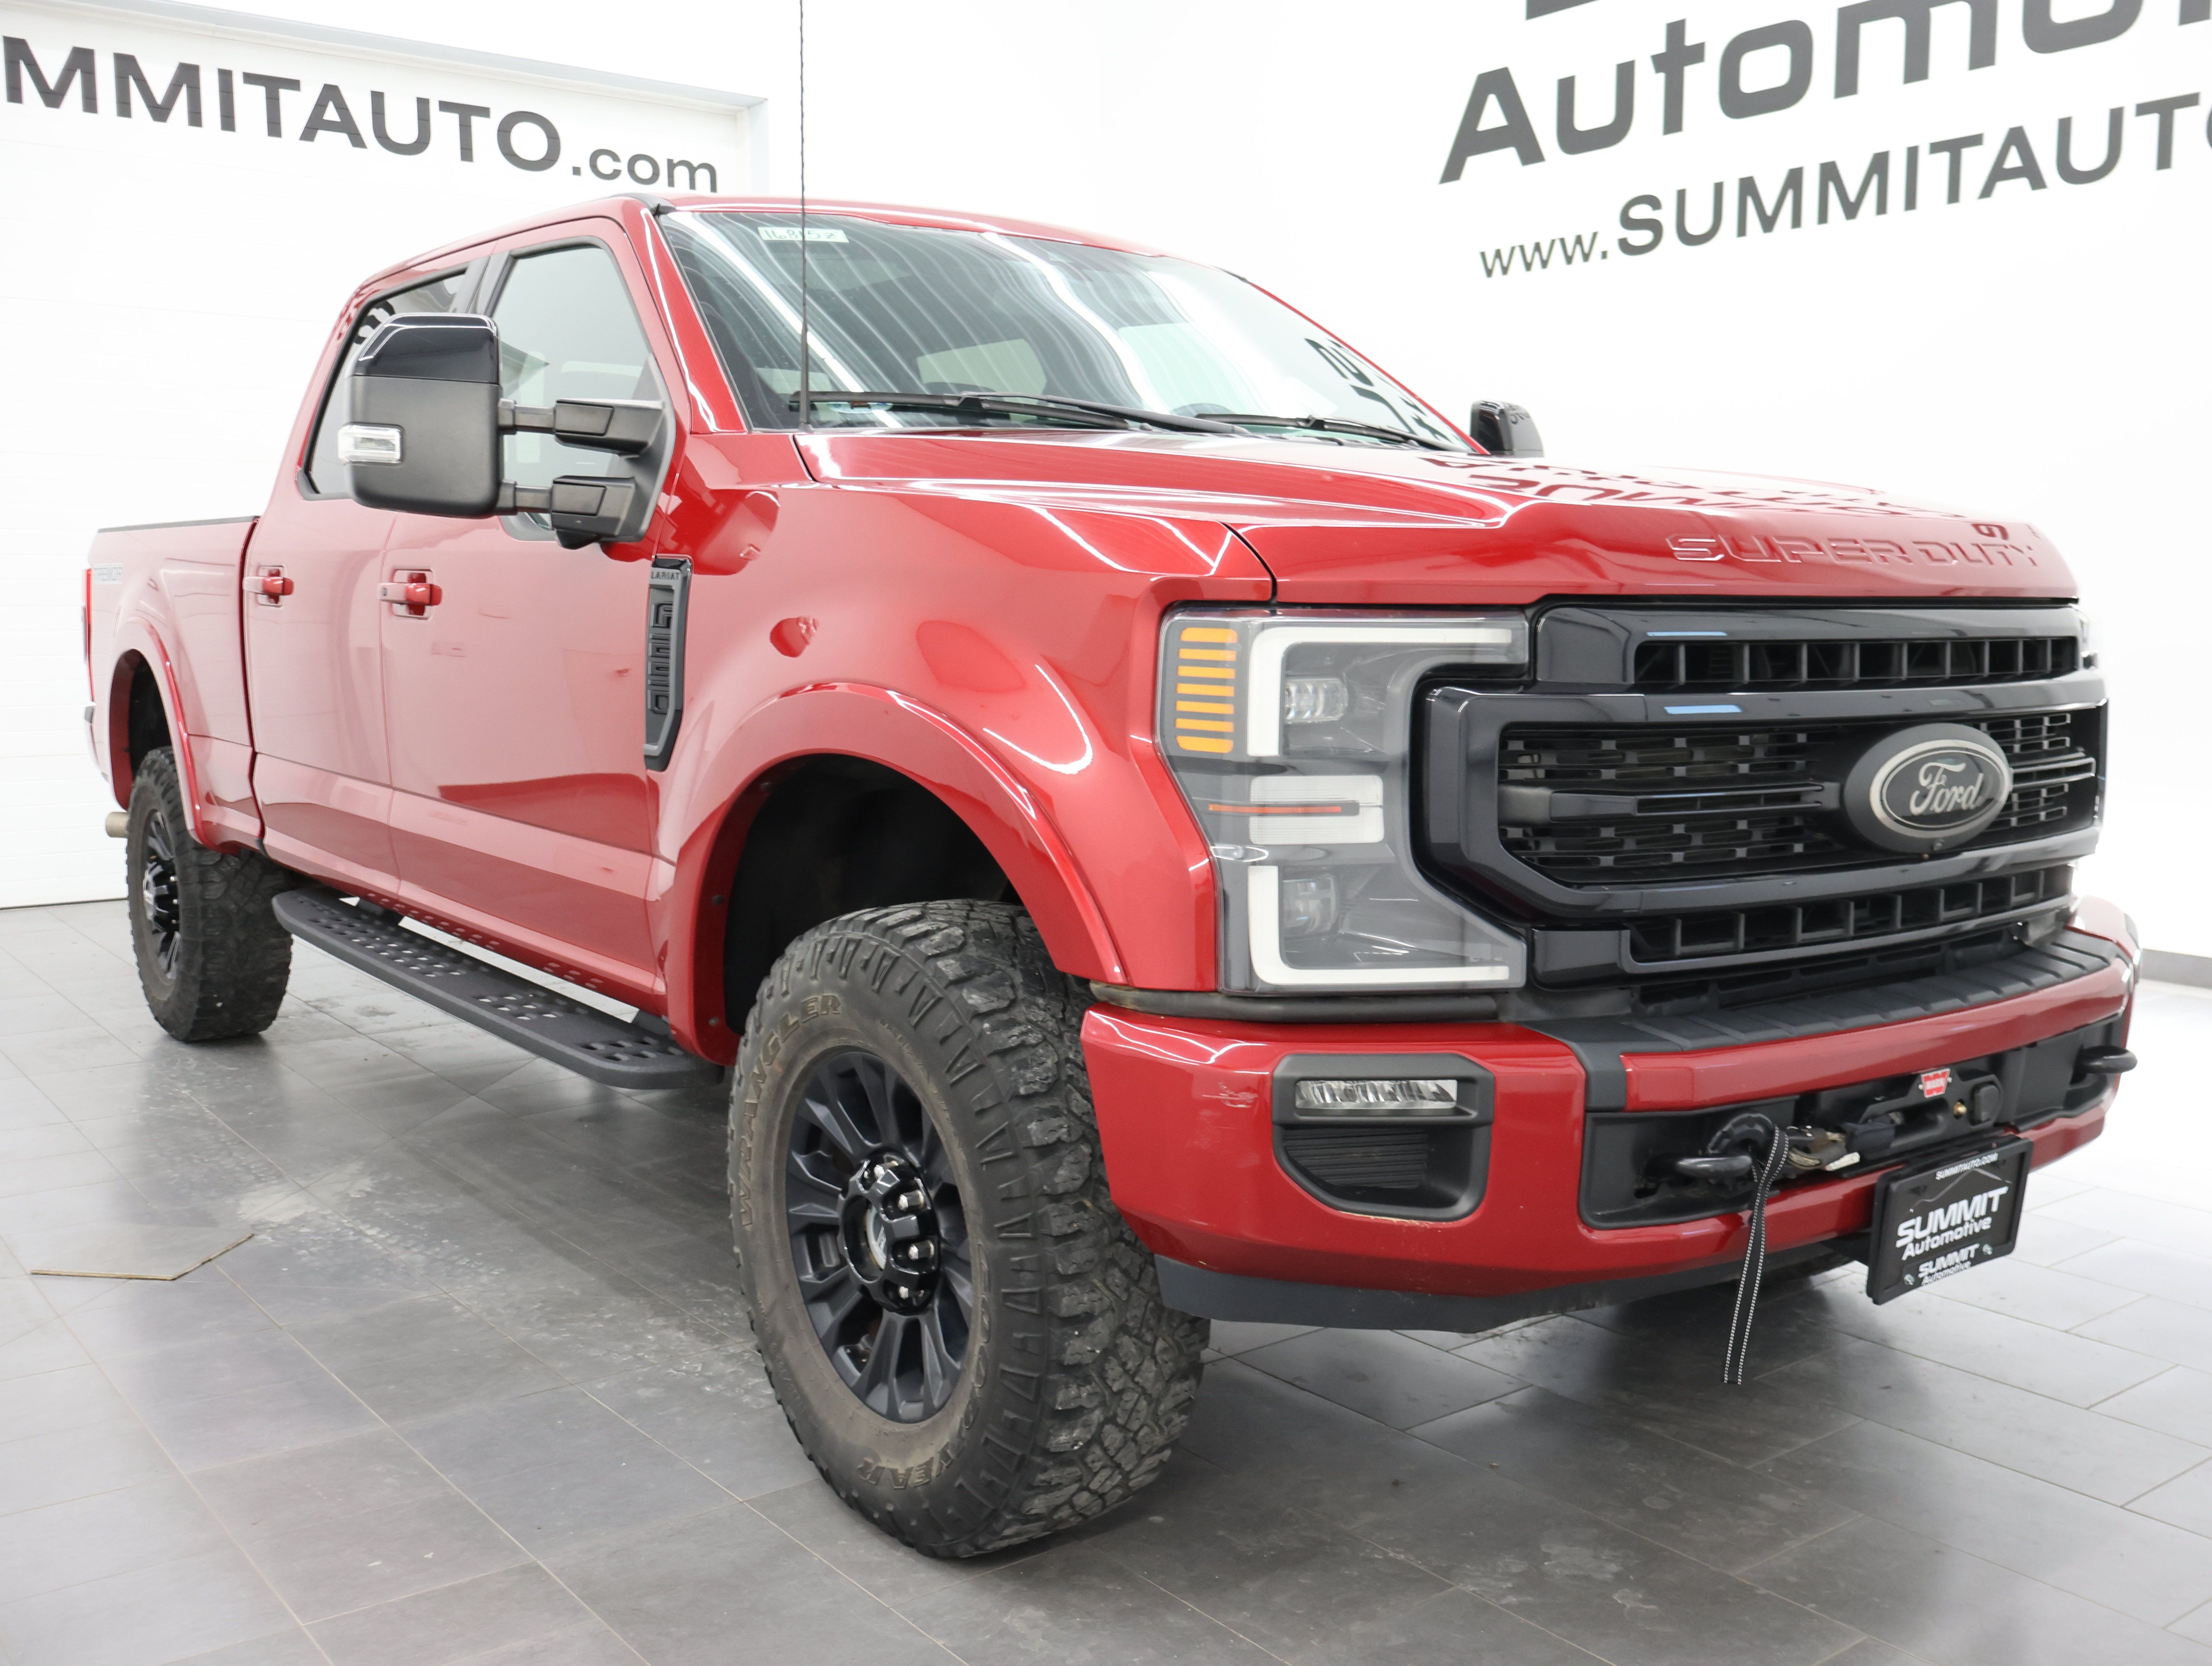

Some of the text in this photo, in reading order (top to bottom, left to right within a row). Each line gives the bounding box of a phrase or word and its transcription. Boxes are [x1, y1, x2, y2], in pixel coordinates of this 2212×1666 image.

[1441, 0, 2211, 184] Autom
[1481, 110, 2212, 277] www.SUMMITAUT
[1666, 534, 2038, 567] SUPER DUTY
[651, 572, 680, 580] LARIAT
[1910, 762, 1983, 816] Ford
[738, 993, 842, 1229] WRANGLER
[1895, 1186, 2009, 1248] SUMMIT
[1902, 1216, 1992, 1261] Automotive
[1918, 1243, 1980, 1278] SUMMIT
[1921, 1261, 1972, 1285] Automotive
